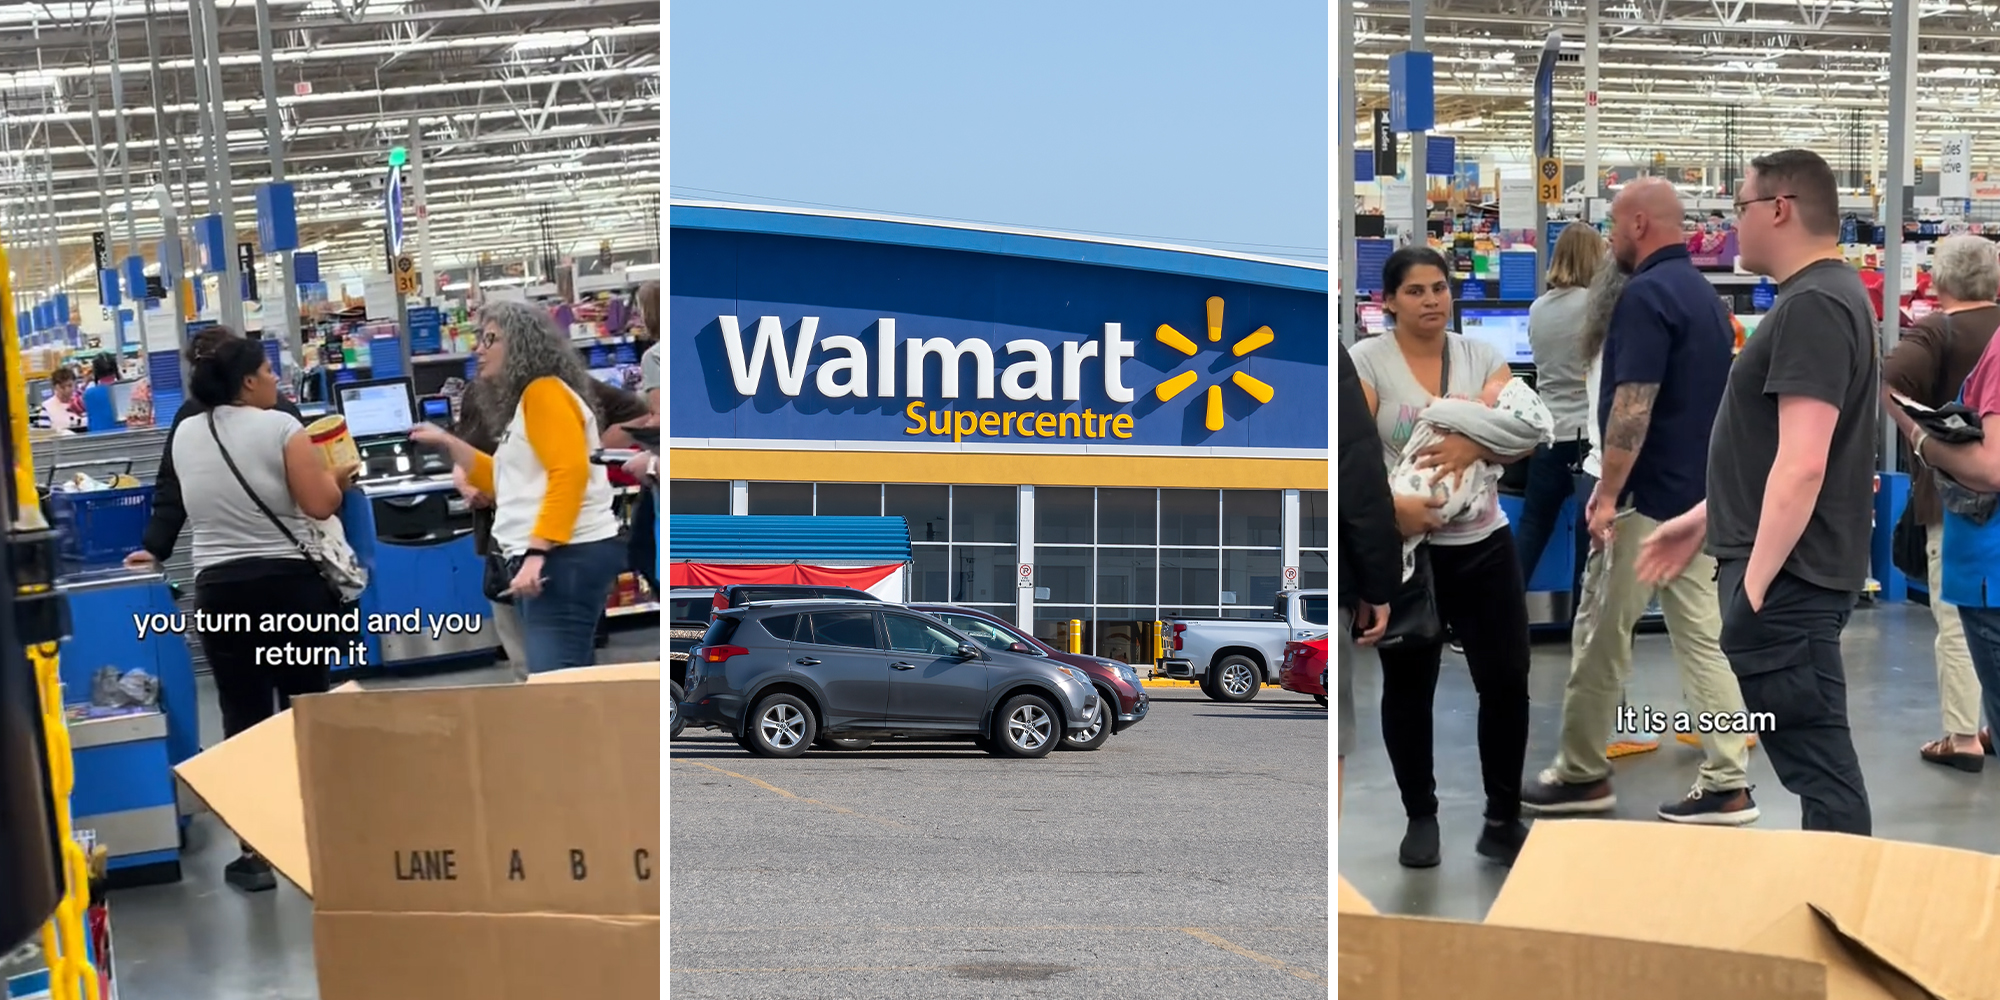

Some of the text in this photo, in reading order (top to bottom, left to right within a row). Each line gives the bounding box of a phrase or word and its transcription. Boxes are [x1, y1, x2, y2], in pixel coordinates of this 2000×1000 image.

[1542, 184, 1558, 200] 31
[400, 276, 414, 291] 31
[719, 315, 1135, 403] Walmart
[905, 401, 1134, 443] Supercentre
[394, 847, 651, 881] LANE A B C
